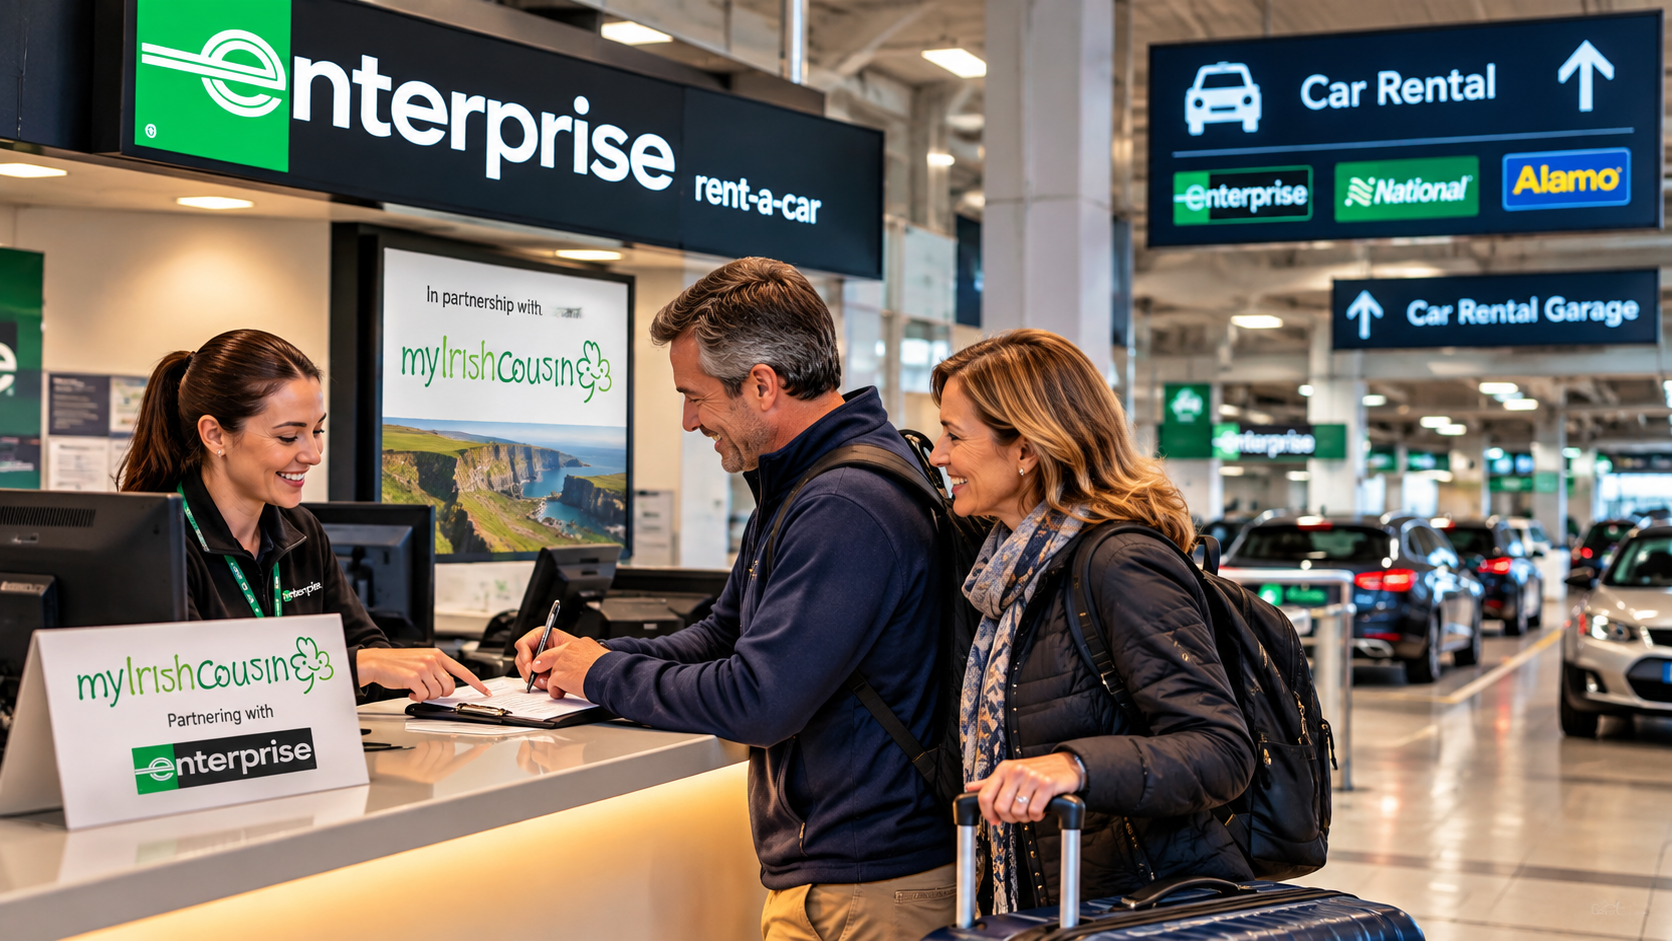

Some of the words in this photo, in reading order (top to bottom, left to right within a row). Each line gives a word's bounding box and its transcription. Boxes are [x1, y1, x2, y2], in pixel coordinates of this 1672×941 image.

[1300, 74, 1367, 110] Car
[1377, 62, 1497, 106] Rental
[142, 28, 676, 192] enterprise
[1174, 179, 1309, 213] enterprise
[1373, 175, 1467, 205] National
[1512, 164, 1619, 196] Alamo
[694, 174, 822, 225] rent-a-car
[426, 285, 438, 303] In
[442, 291, 515, 316] partnership
[517, 299, 543, 316] with
[1406, 300, 1454, 327] Car
[1457, 295, 1539, 325] Rental
[1543, 295, 1640, 328] Garage
[167, 708, 242, 728] Partnering
[245, 703, 274, 720] with
[134, 738, 312, 783] enterprise
